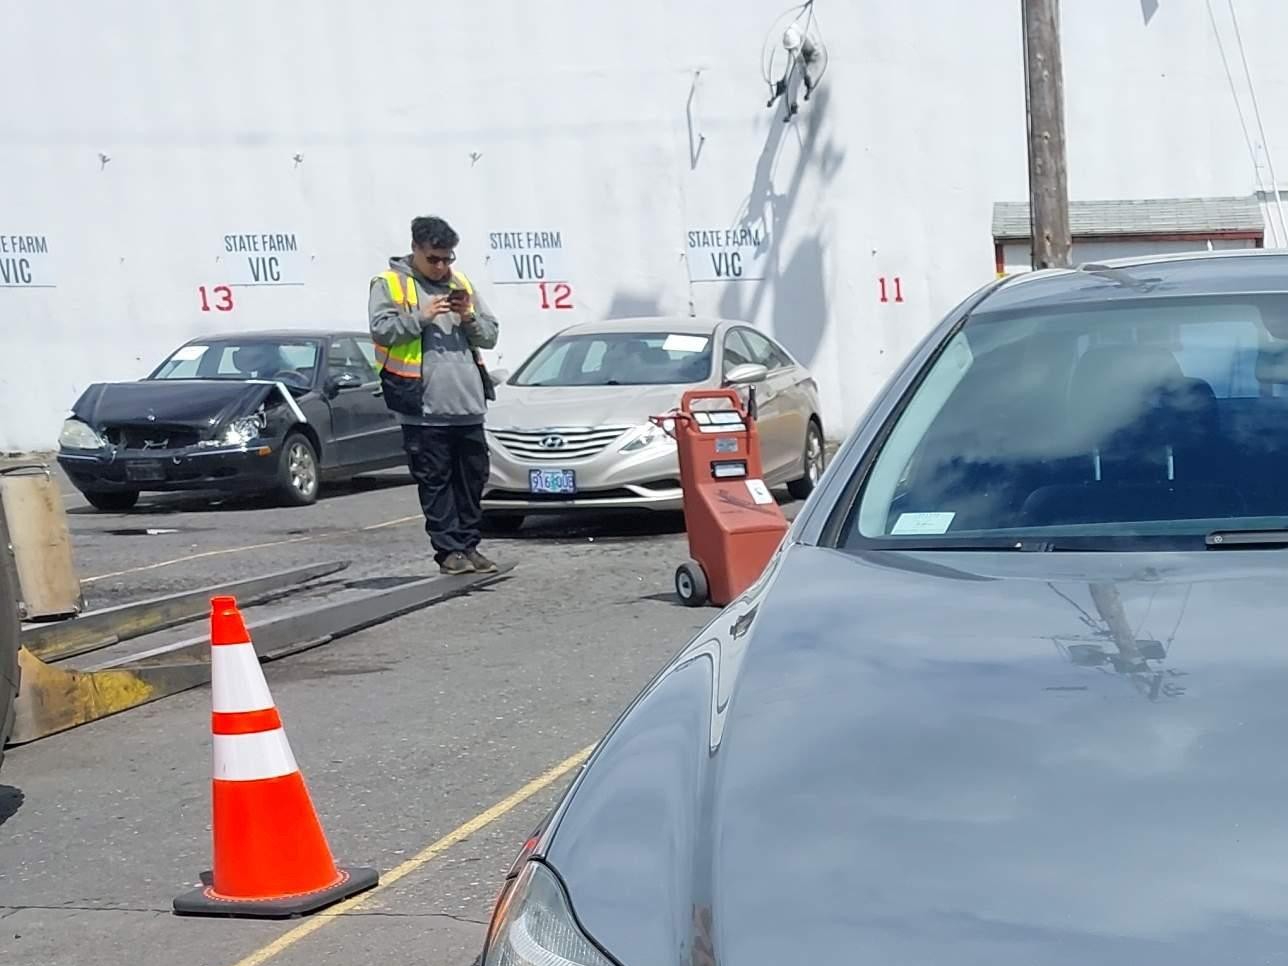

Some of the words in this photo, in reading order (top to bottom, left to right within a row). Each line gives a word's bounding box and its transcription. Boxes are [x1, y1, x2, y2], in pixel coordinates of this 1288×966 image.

[10, 235, 49, 254] FARM
[224, 234, 260, 253] STATE
[261, 234, 298, 252] FARM
[489, 231, 525, 250] STATE
[526, 231, 562, 250] FARM
[687, 231, 723, 249] STATE
[725, 229, 761, 250] FARM
[0, 258, 32, 284] VIC
[248, 256, 281, 283] VIC
[512, 254, 545, 280] VIC
[711, 252, 745, 280] VIC
[199, 286, 234, 312] 13
[538, 283, 572, 310] 12
[879, 278, 904, 304] 11
